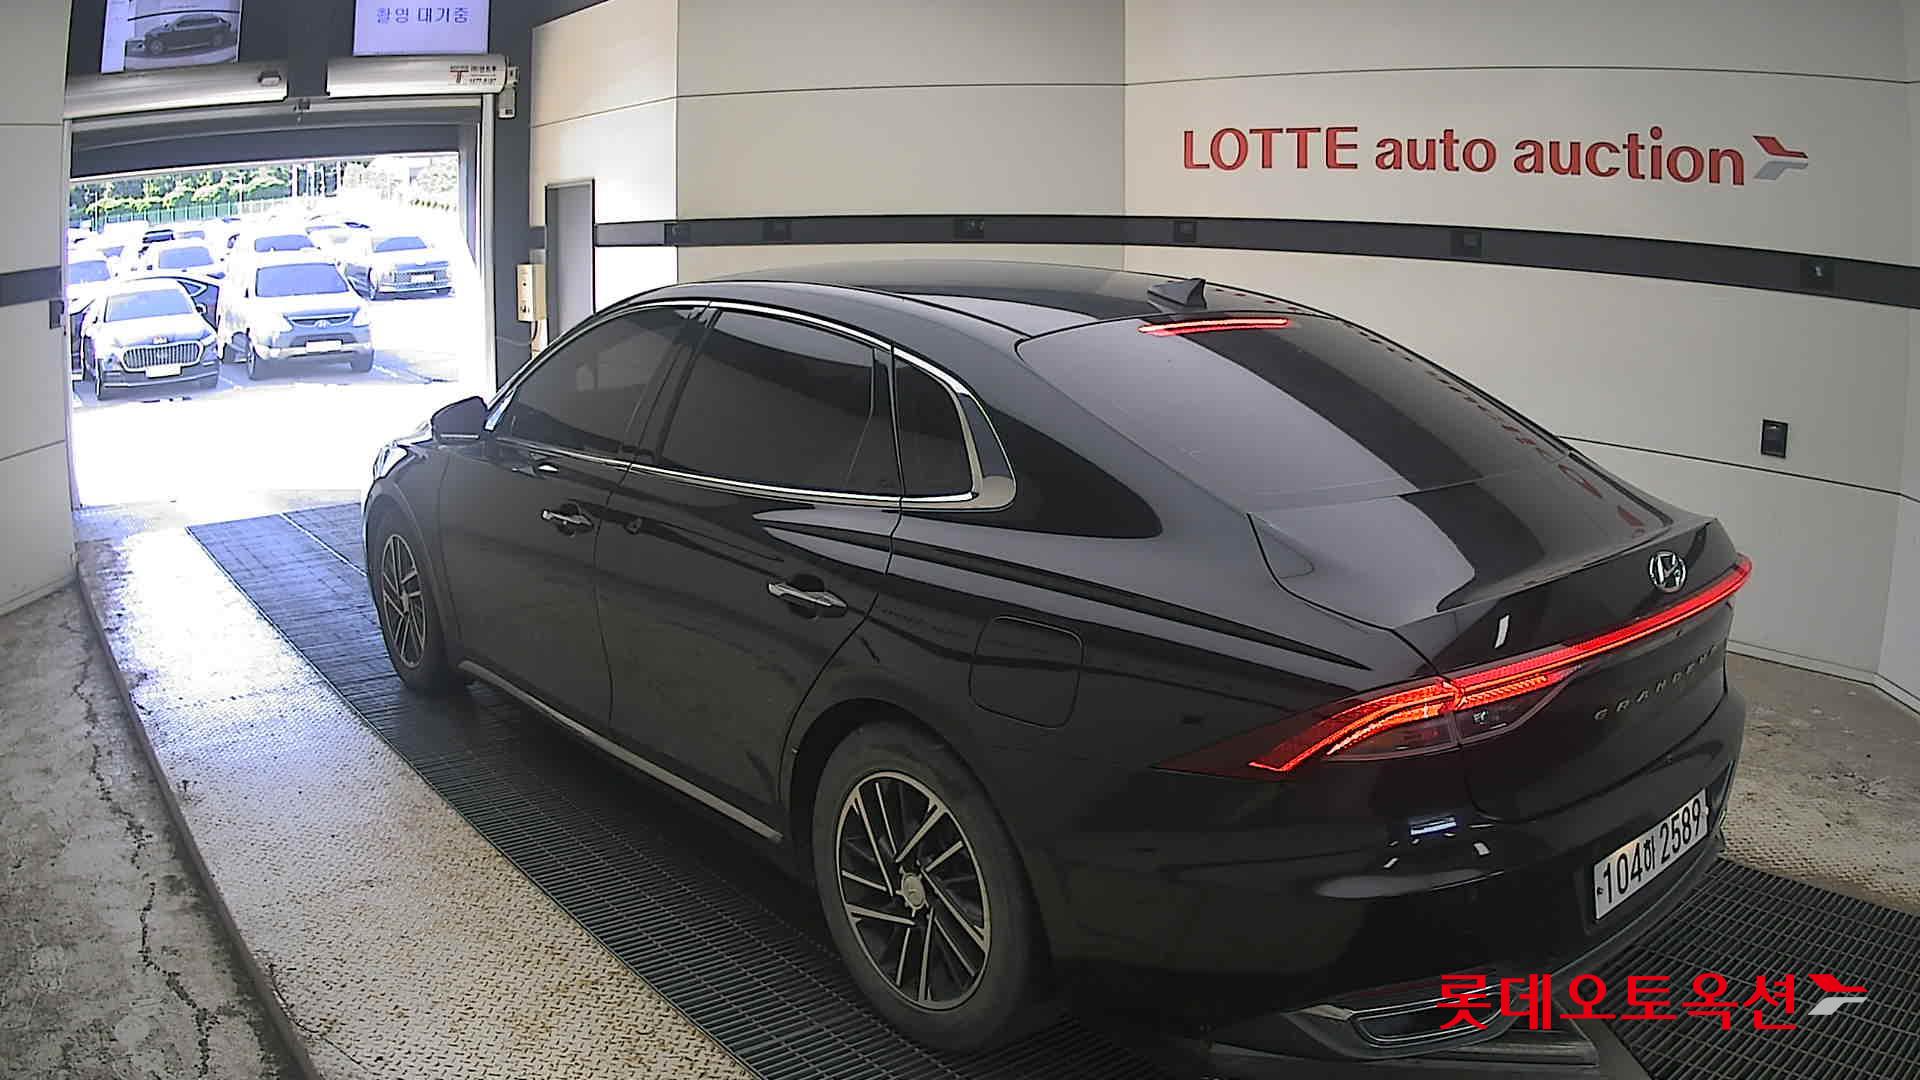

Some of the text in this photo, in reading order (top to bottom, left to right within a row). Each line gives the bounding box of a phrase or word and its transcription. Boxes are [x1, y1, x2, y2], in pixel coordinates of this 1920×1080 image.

[417, 7, 471, 24] 대기중
[1183, 126, 1745, 186] LOTTE auto auction
